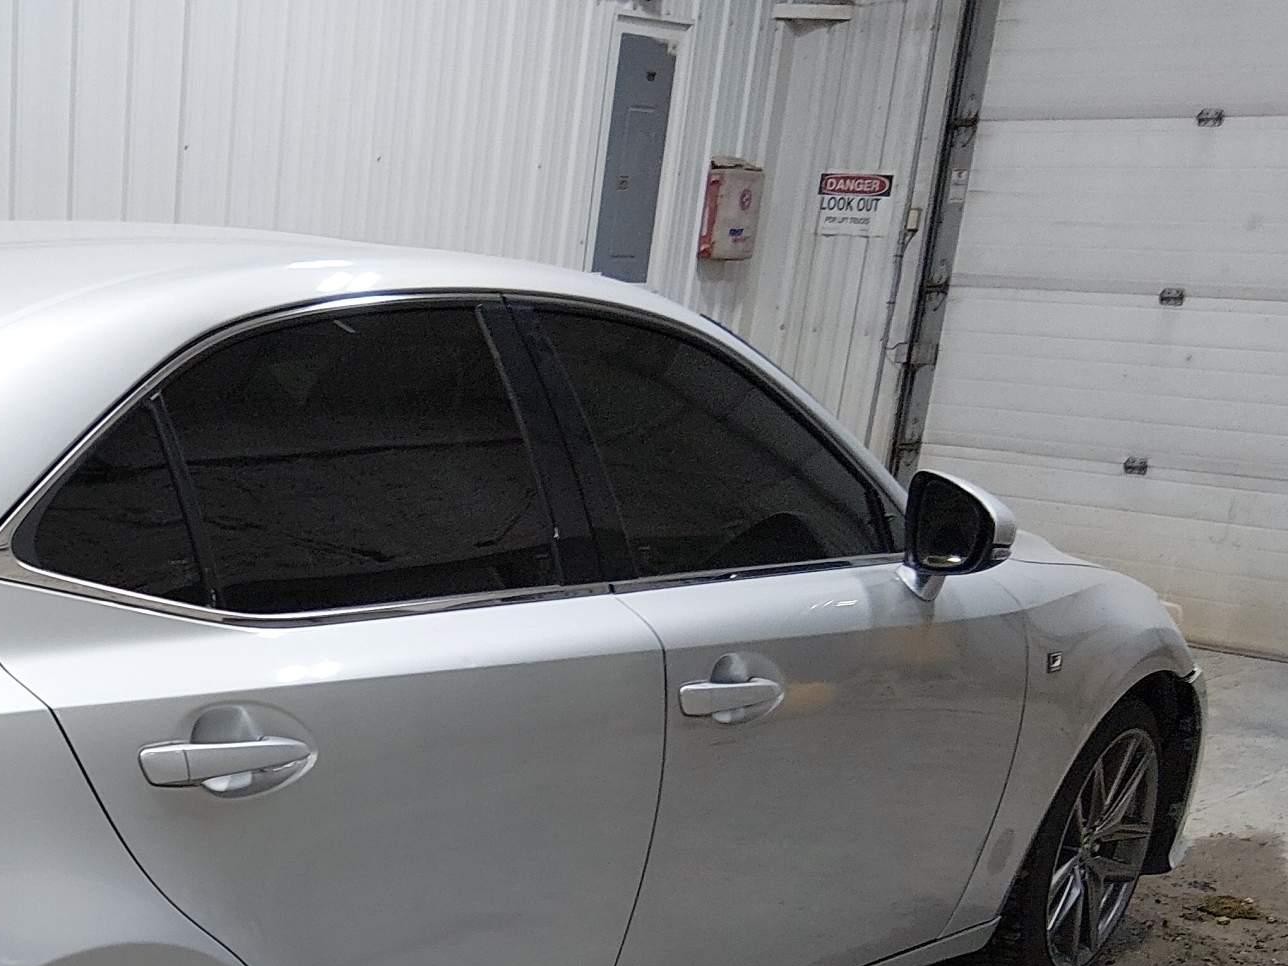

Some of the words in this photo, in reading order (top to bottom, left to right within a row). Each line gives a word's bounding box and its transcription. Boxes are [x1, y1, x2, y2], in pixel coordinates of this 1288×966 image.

[826, 178, 880, 191] DANGER
[819, 197, 854, 211] LOOK
[857, 198, 881, 212] OUT
